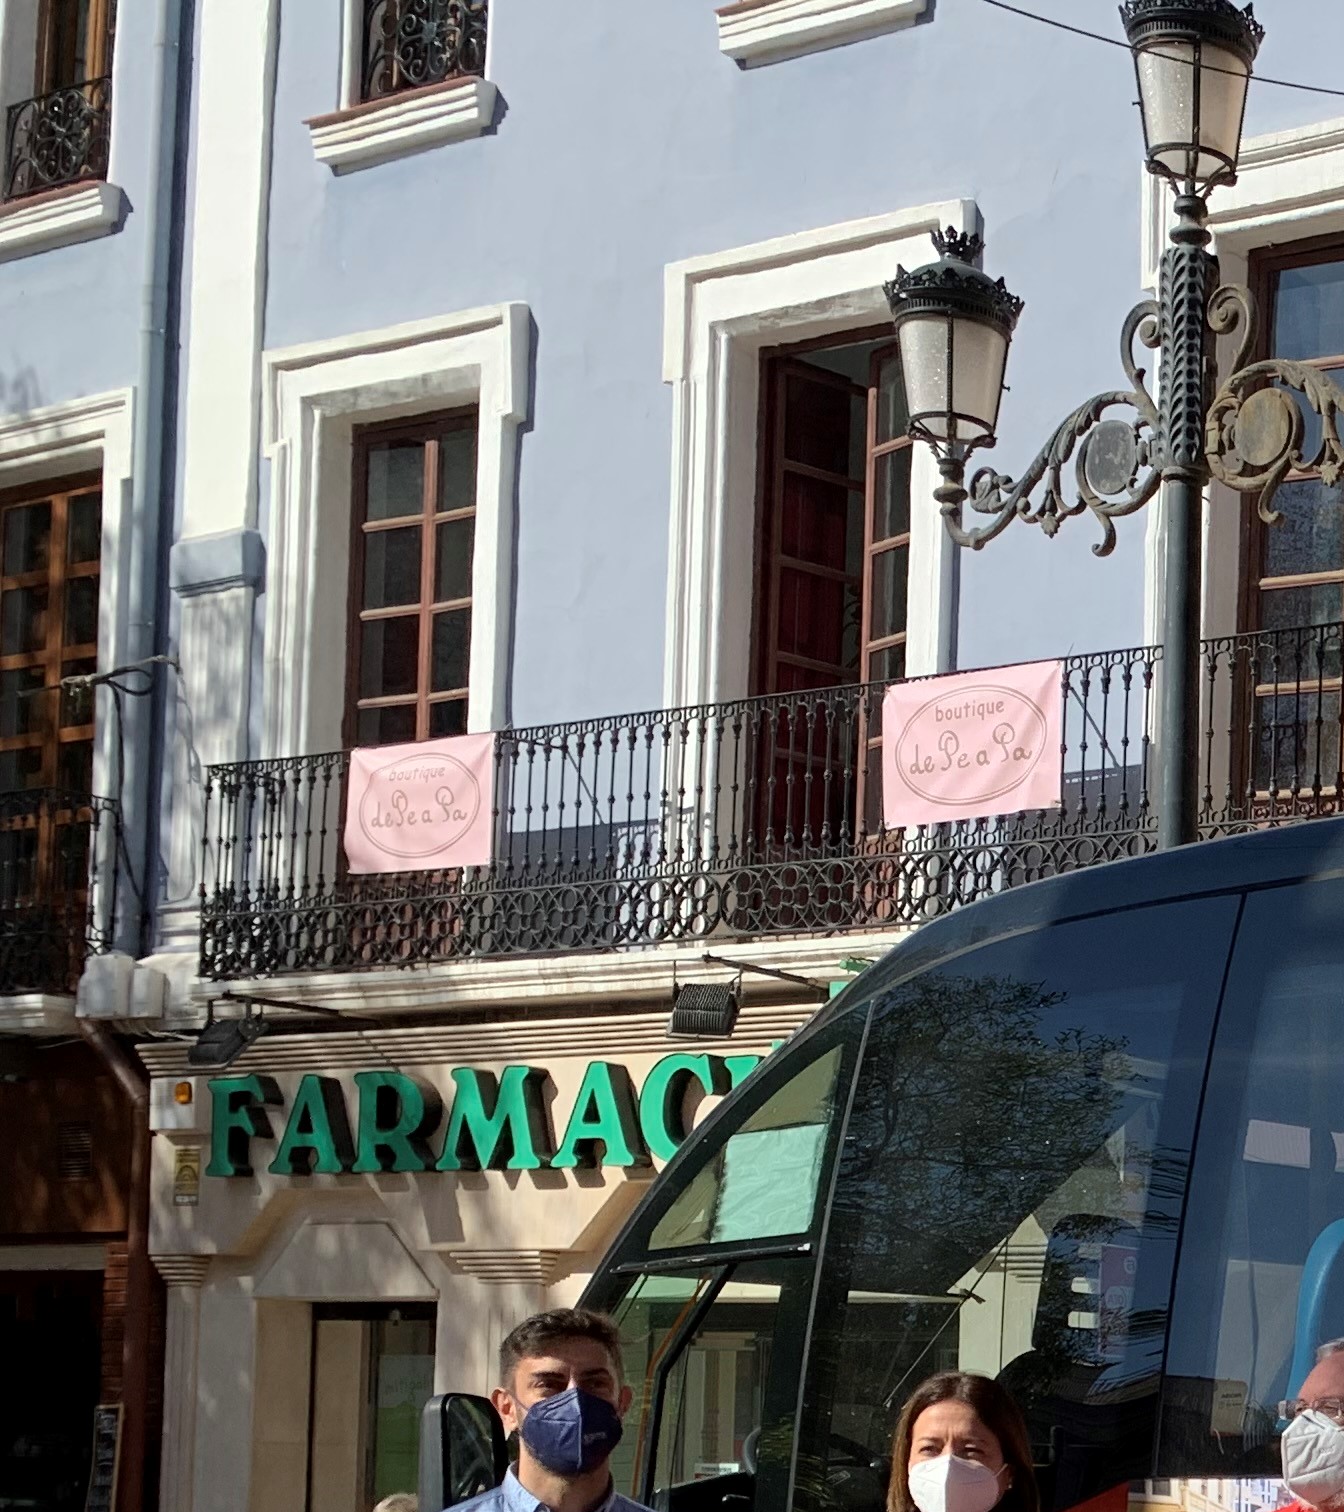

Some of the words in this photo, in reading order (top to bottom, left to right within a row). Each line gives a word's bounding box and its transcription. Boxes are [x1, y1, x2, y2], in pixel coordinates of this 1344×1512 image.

[934, 700, 1005, 723] boutique
[909, 743, 936, 775] de
[975, 750, 991, 767] a
[389, 767, 445, 782] boutique
[372, 803, 393, 828] de
